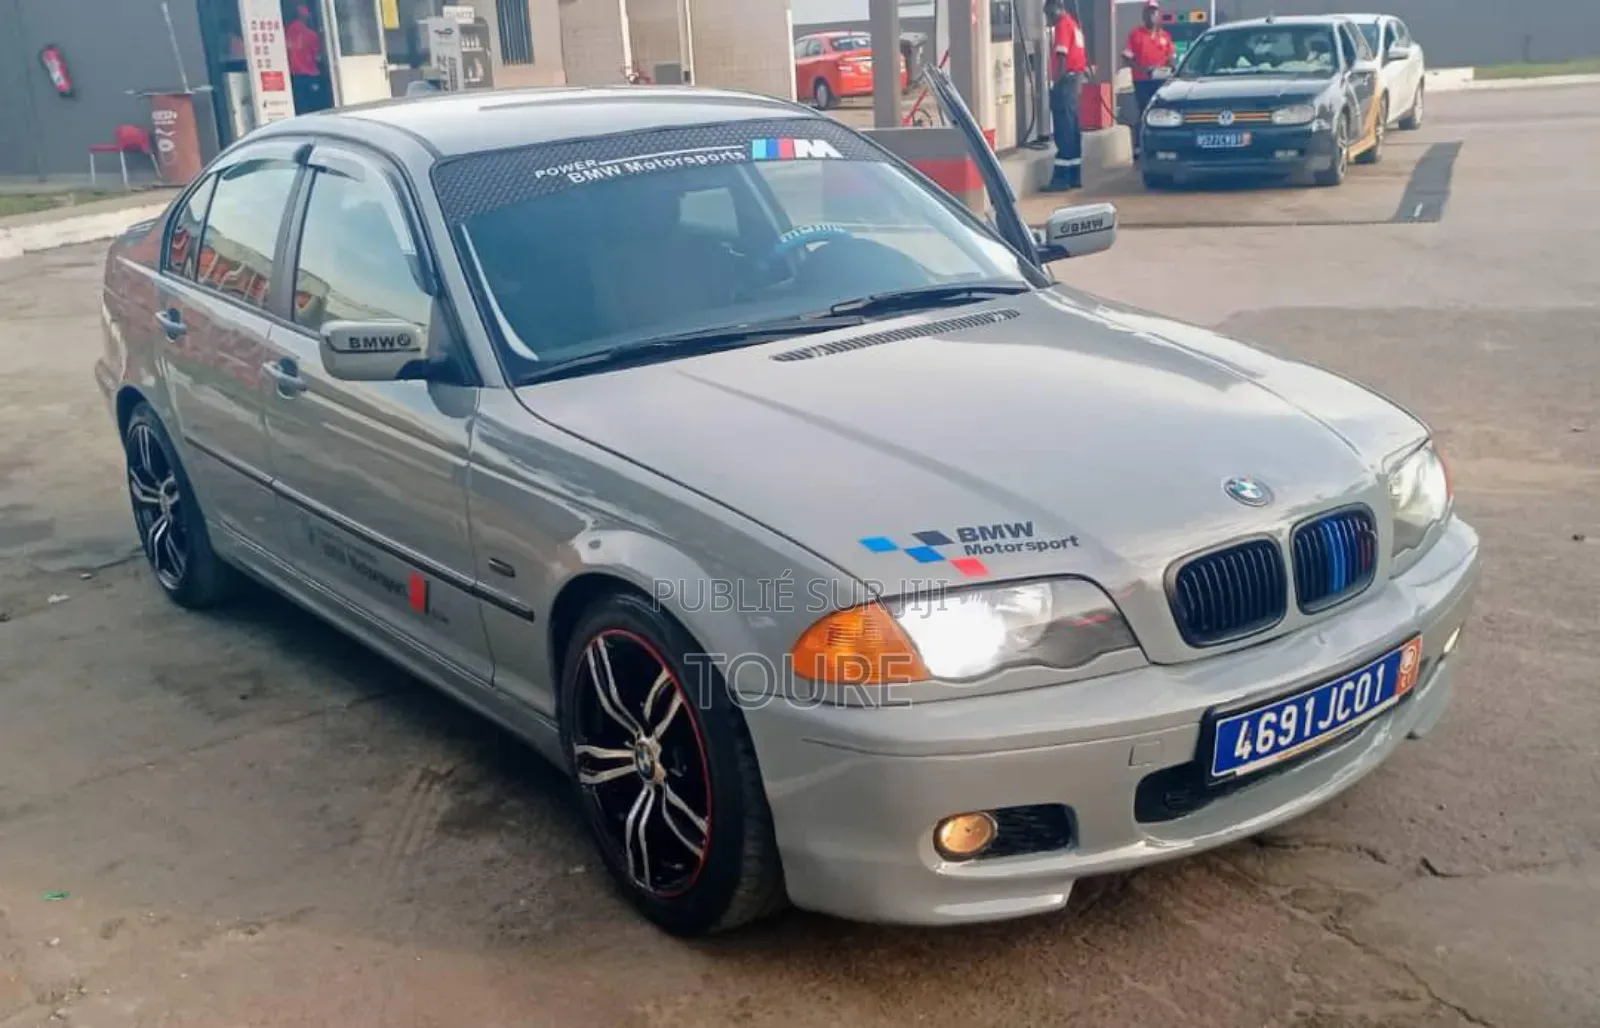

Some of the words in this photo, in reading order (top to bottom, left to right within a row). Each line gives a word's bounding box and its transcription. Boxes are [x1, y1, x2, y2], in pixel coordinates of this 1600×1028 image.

[535, 159, 597, 178] POWER
[568, 165, 622, 184] BMW
[627, 150, 745, 174] Motorsports
[348, 336, 395, 349] BMW
[956, 521, 1034, 543] BMW
[963, 534, 1080, 556] Motorsport
[1233, 663, 1385, 759] 4691JC01
